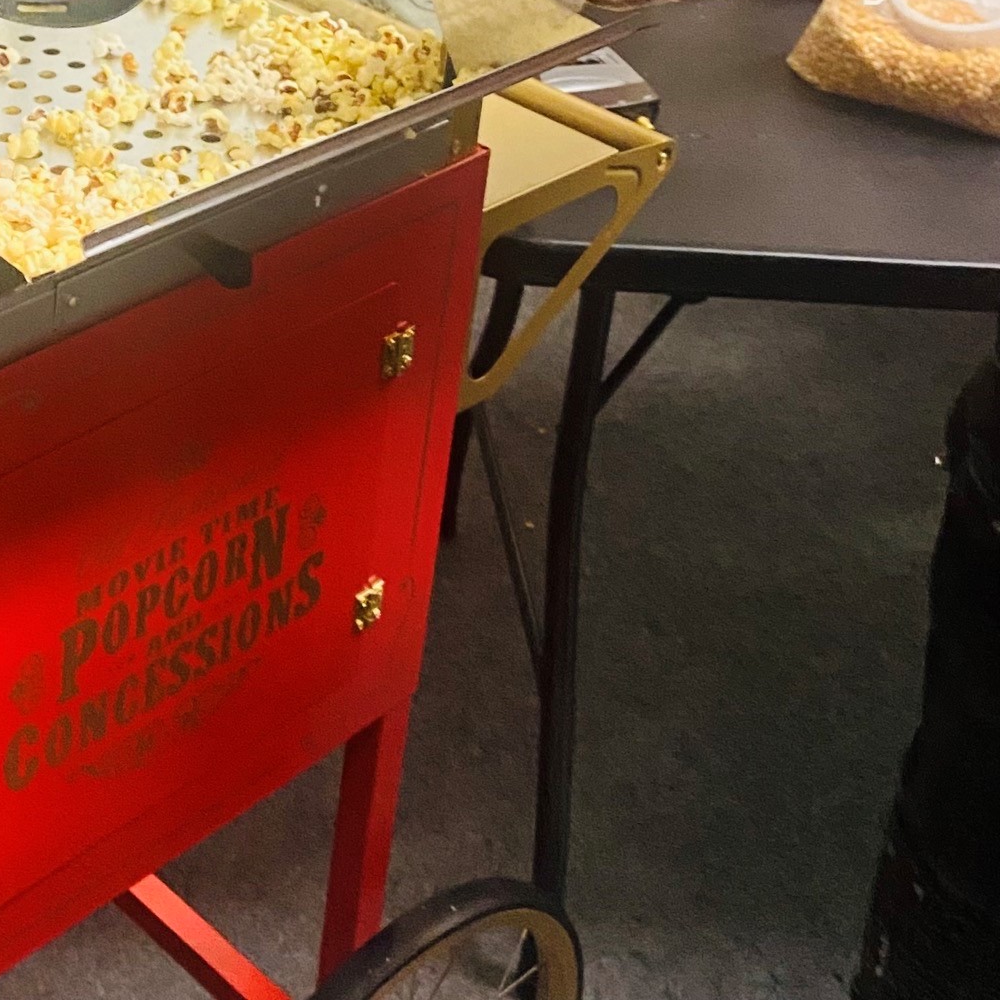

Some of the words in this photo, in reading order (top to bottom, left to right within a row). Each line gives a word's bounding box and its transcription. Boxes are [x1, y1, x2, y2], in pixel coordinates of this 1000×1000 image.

[59, 503, 289, 703] POPCORN
[76, 537, 186, 616] MOVIE
[201, 486, 280, 545] TIME
[148, 611, 200, 656] AND
[4, 551, 324, 791] CONCESSIONS
